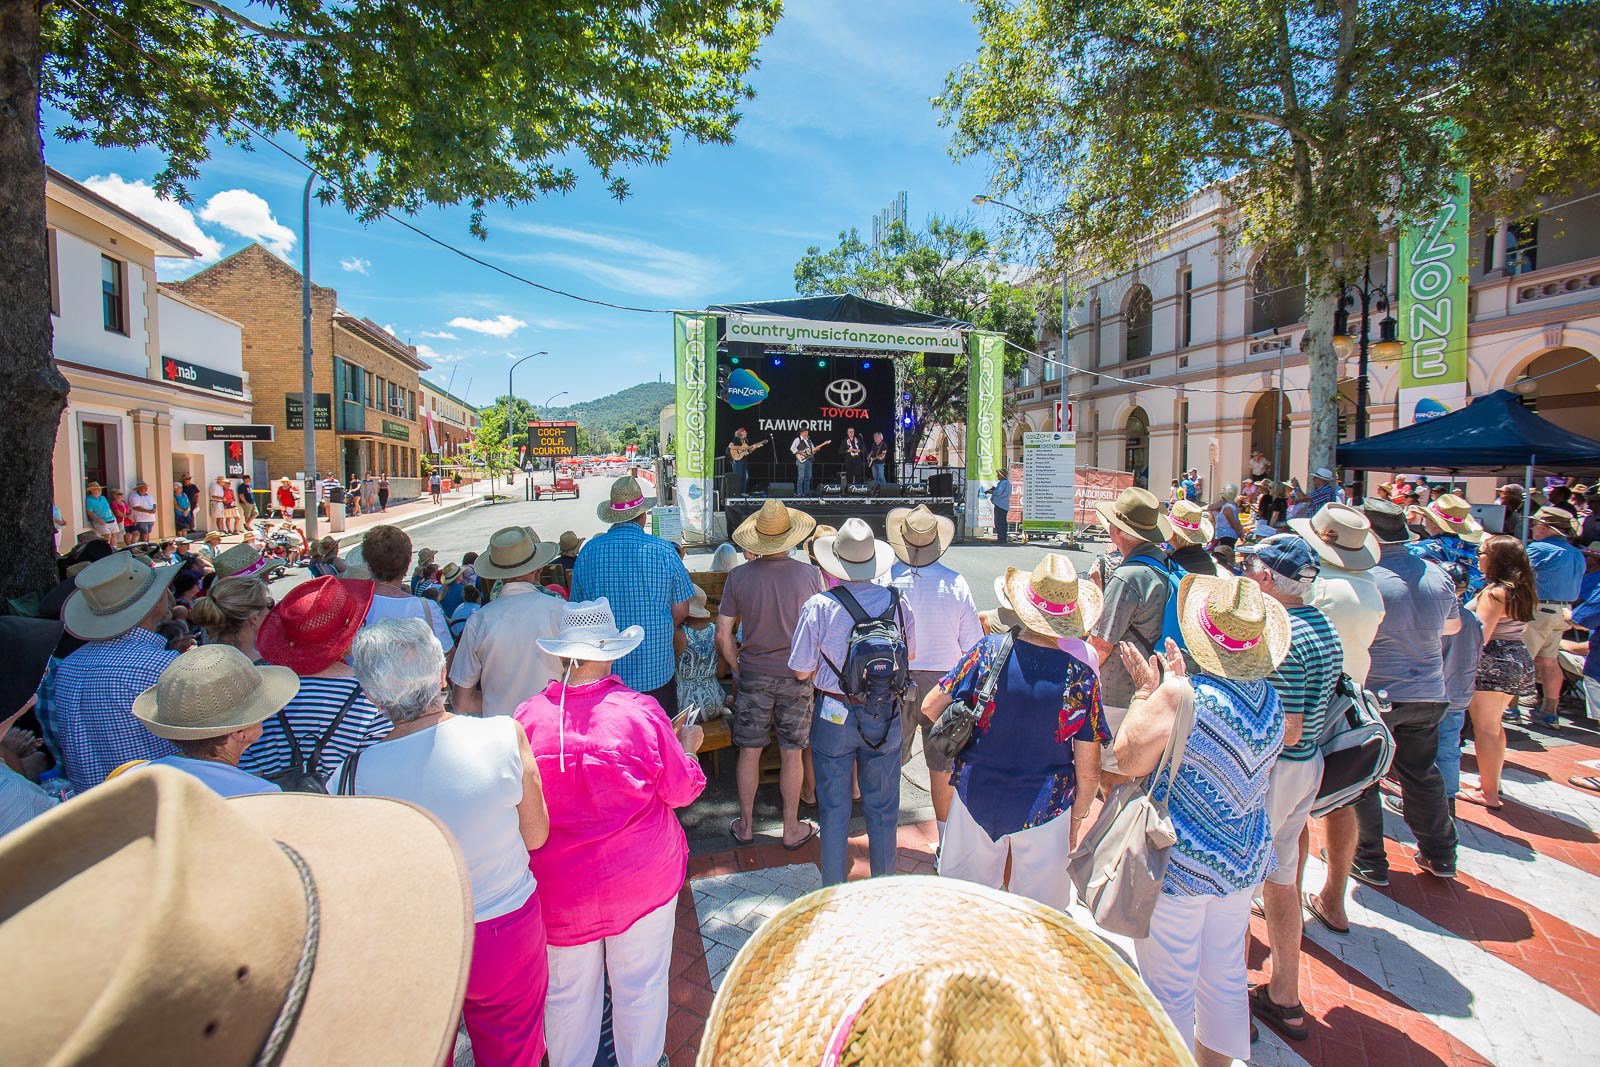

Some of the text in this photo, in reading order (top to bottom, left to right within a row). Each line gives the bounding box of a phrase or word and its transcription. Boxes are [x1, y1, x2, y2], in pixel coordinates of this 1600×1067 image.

[731, 322, 959, 348] countrymusicfanzone.com.au
[177, 366, 197, 381] nab
[685, 319, 708, 473] FANZONE
[728, 387, 765, 397] FANZONE
[820, 407, 870, 419] TOYOTA
[977, 338, 995, 476] FANZONE
[758, 418, 832, 432] TAMWORTH
[537, 428, 567, 437] COCA-
[540, 437, 564, 446] COLA
[532, 446, 573, 455] COUNTRY
[229, 462, 243, 475] nab
[1075, 488, 1114, 500] ANDCRUISER
